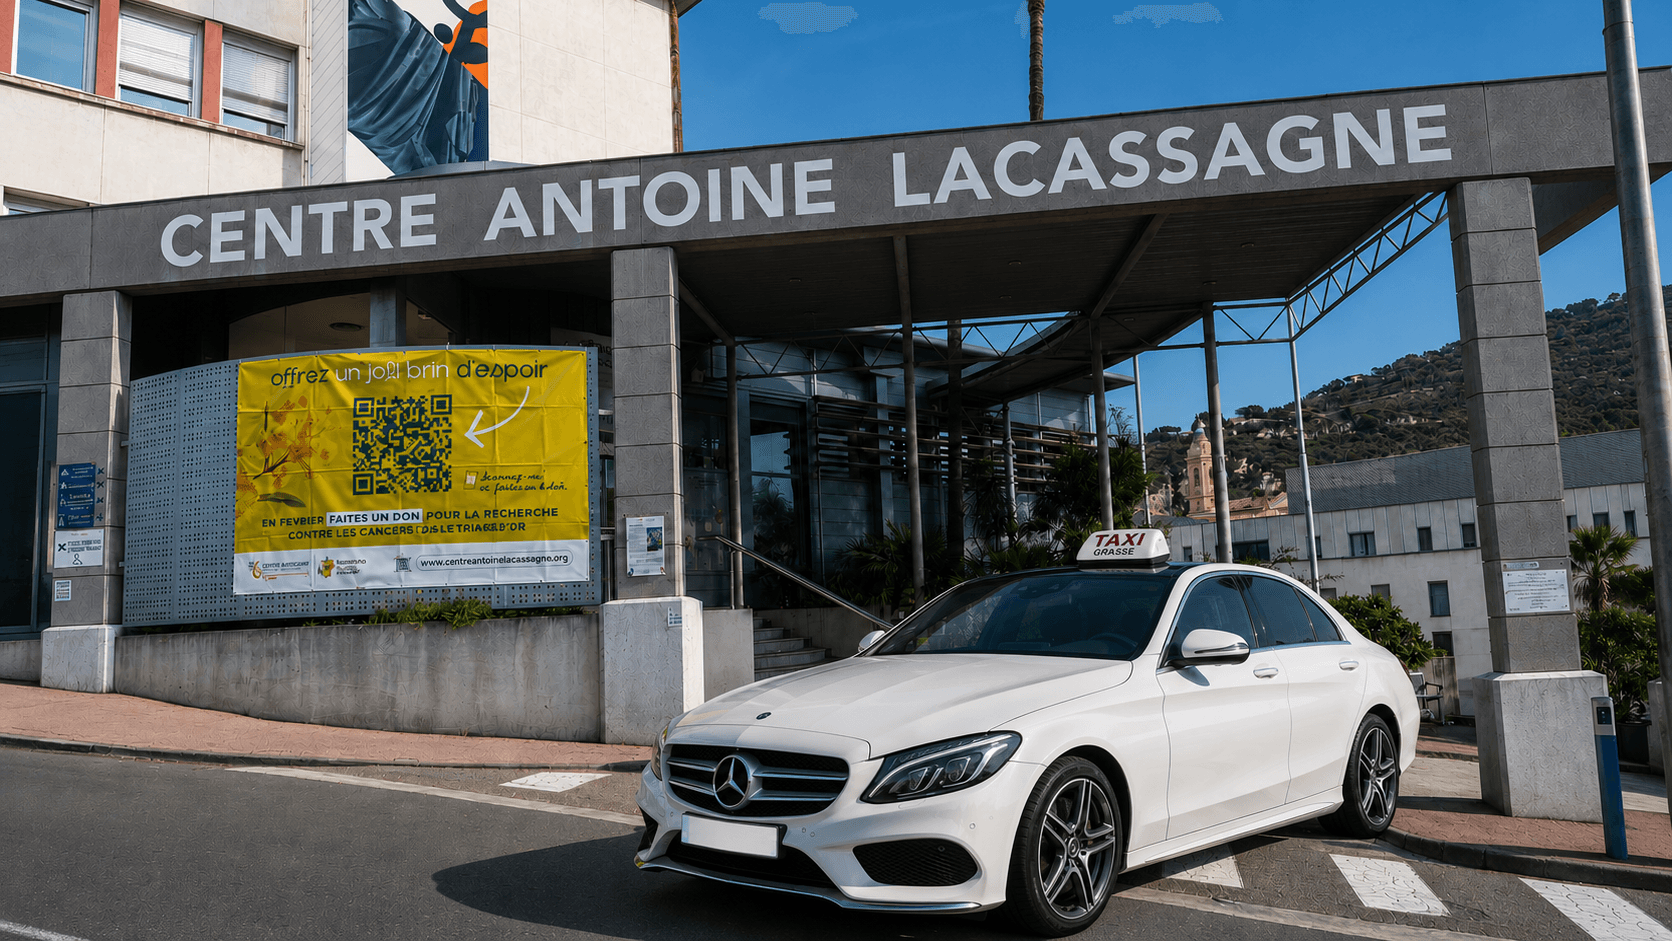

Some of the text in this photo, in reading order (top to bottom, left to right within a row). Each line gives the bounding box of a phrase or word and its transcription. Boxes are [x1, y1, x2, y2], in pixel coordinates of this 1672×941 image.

[160, 104, 1452, 268] CENTRE ANTOINE LACASSAGNE
[271, 367, 329, 388] offrez
[336, 368, 361, 382] un
[406, 361, 449, 379] brin
[457, 360, 548, 382] d'espoir
[262, 518, 276, 527] EN
[329, 513, 368, 524] FAITES
[371, 513, 389, 522] UN
[393, 511, 420, 521] DON
[426, 511, 460, 520] POUR
[465, 510, 480, 519] LA
[484, 507, 559, 518] RECHERCHE
[288, 529, 333, 540] CONTRE
[336, 528, 356, 538] LES
[359, 525, 414, 536] CANCERS
[1095, 532, 1146, 548] TAXI
[1093, 548, 1135, 557] GRASSE
